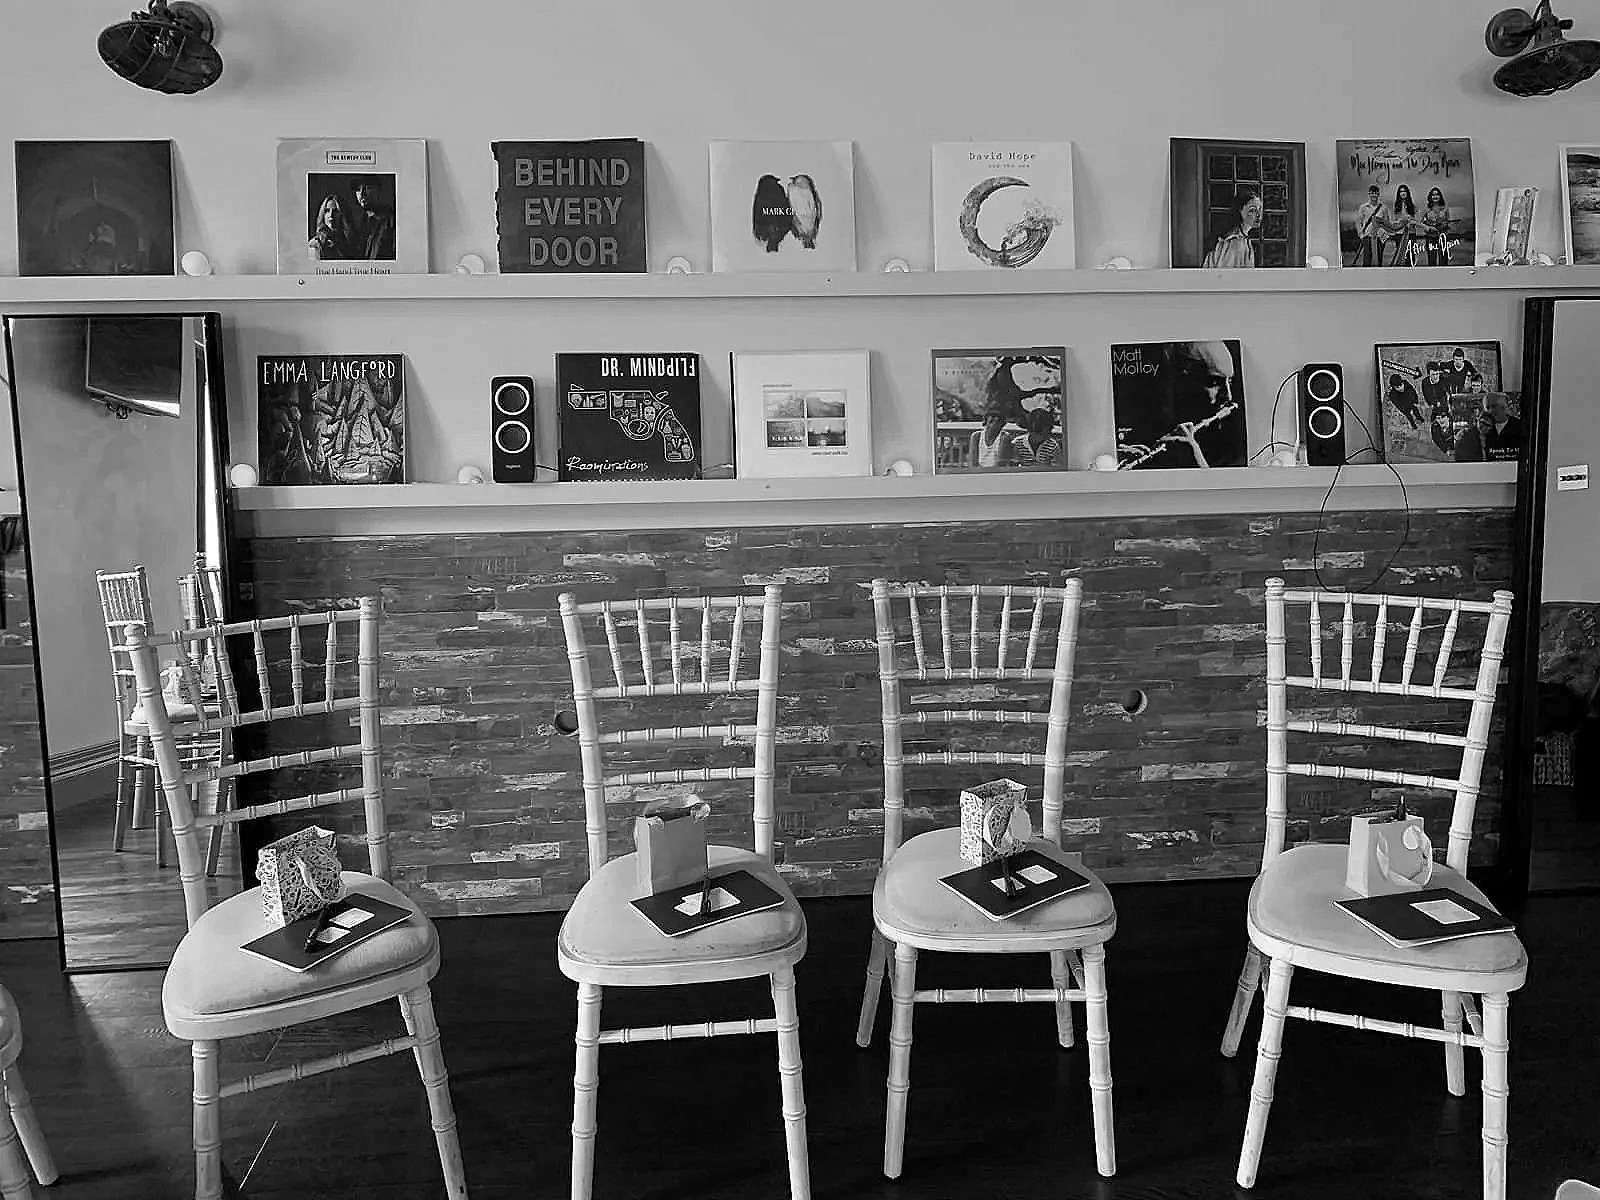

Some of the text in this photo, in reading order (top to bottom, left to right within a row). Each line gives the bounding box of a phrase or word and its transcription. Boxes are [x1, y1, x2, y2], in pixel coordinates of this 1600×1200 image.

[968, 152, 1037, 161] David Hope
[515, 158, 630, 186] BEHIND
[525, 197, 622, 226] EVERY
[762, 207, 785, 216] MARK
[529, 236, 618, 267] DOOR
[1112, 348, 1142, 362] Matt
[263, 360, 395, 385] EMMA LANGFORD
[601, 357, 624, 377] DR.
[1114, 361, 1160, 376] Molloy
